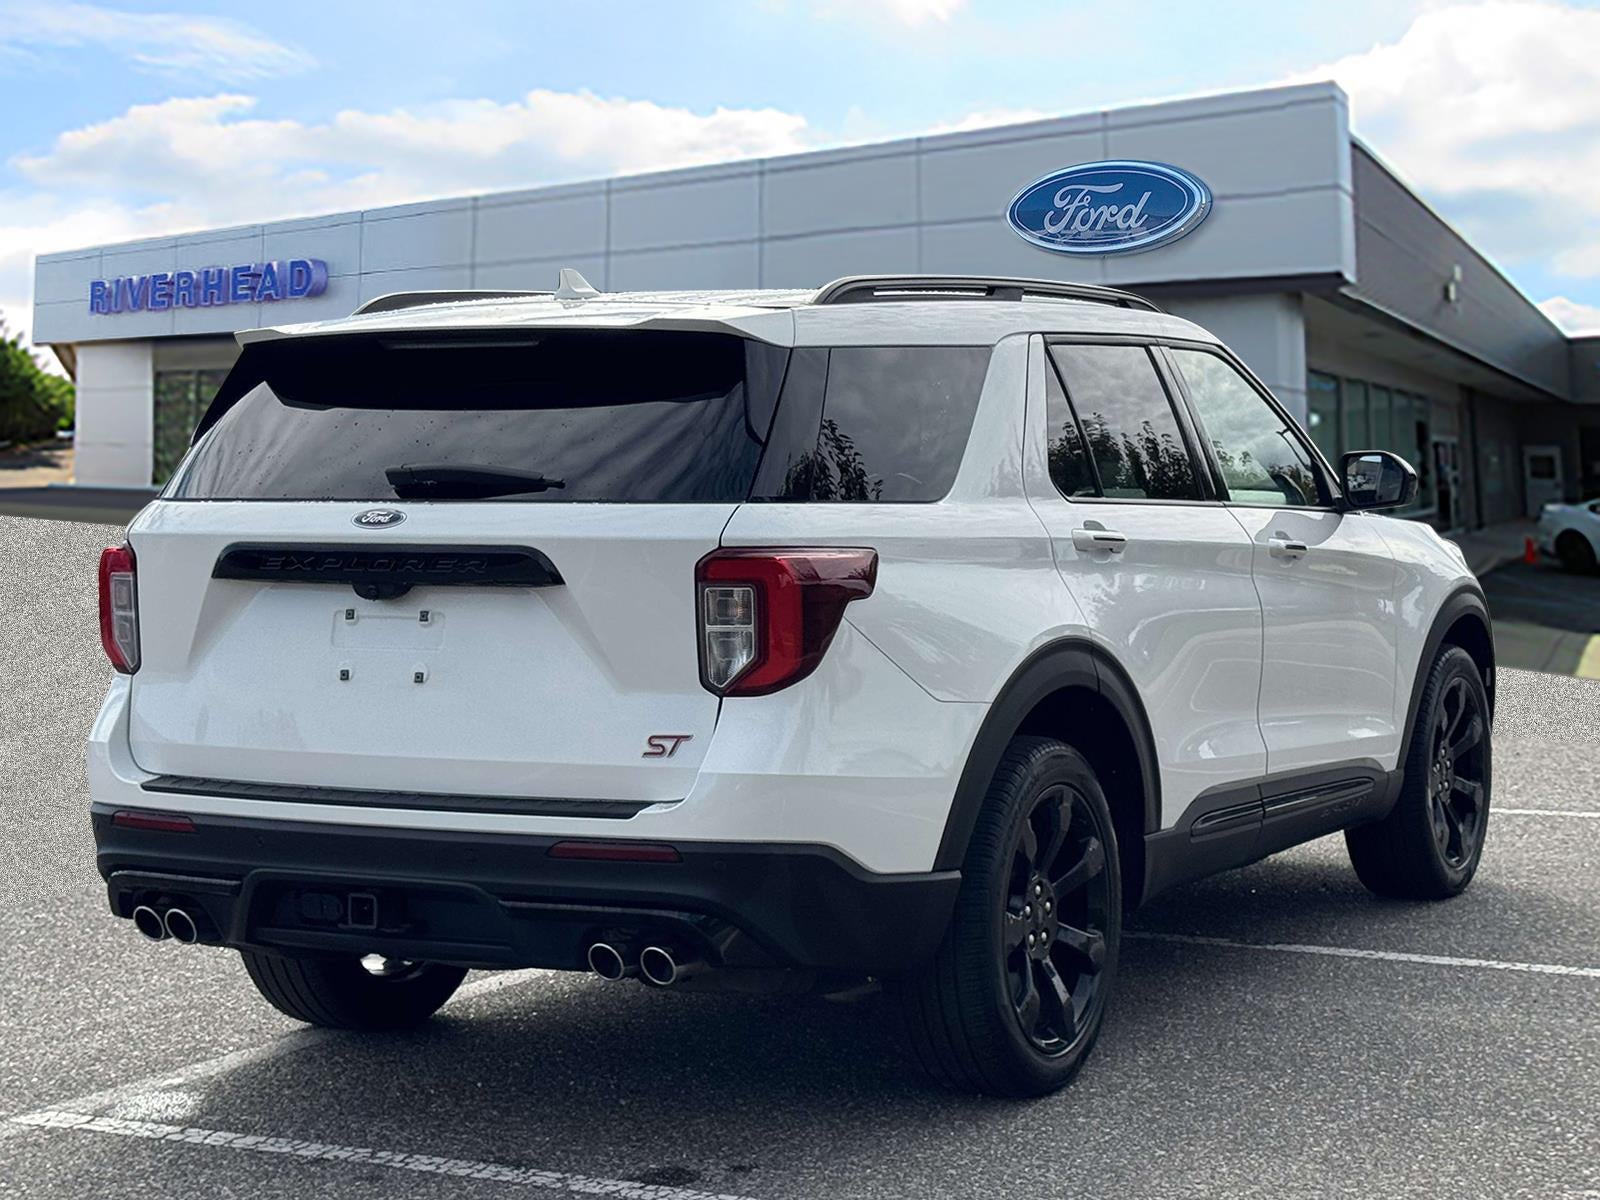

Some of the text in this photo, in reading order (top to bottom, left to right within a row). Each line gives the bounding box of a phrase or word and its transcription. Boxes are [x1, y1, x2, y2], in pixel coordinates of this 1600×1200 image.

[1044, 182, 1152, 234] Ford
[90, 259, 327, 314] RIVERHEAD
[360, 510, 392, 524] Ford
[260, 556, 488, 574] EXPLORER
[641, 734, 694, 758] ST
